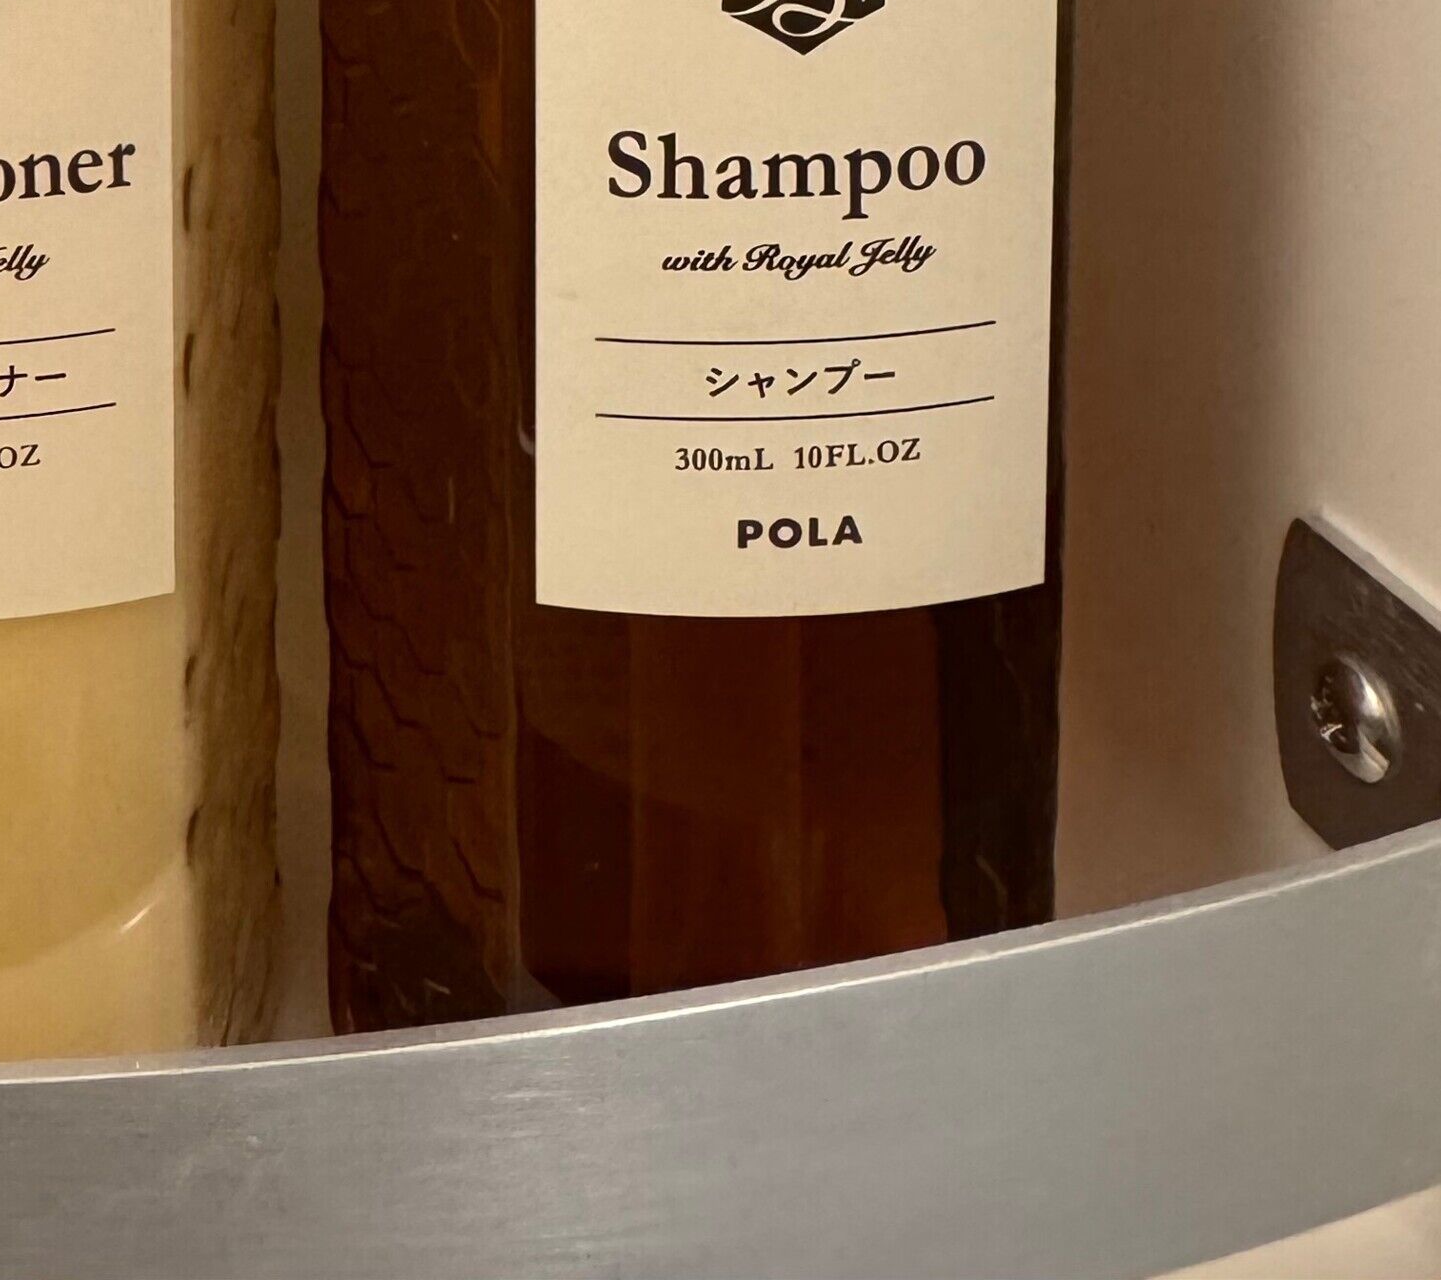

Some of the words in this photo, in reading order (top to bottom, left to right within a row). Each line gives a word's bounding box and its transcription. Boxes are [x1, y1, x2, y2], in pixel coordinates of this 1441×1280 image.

[607, 130, 986, 221] Shampoo
[661, 245, 738, 272] with
[741, 241, 851, 281] Royal
[850, 234, 937, 277] Jelly
[705, 358, 896, 399] シャンプー
[674, 447, 774, 472] 300mL
[794, 437, 921, 470] 10FL.OZ
[737, 515, 863, 550] POLA
